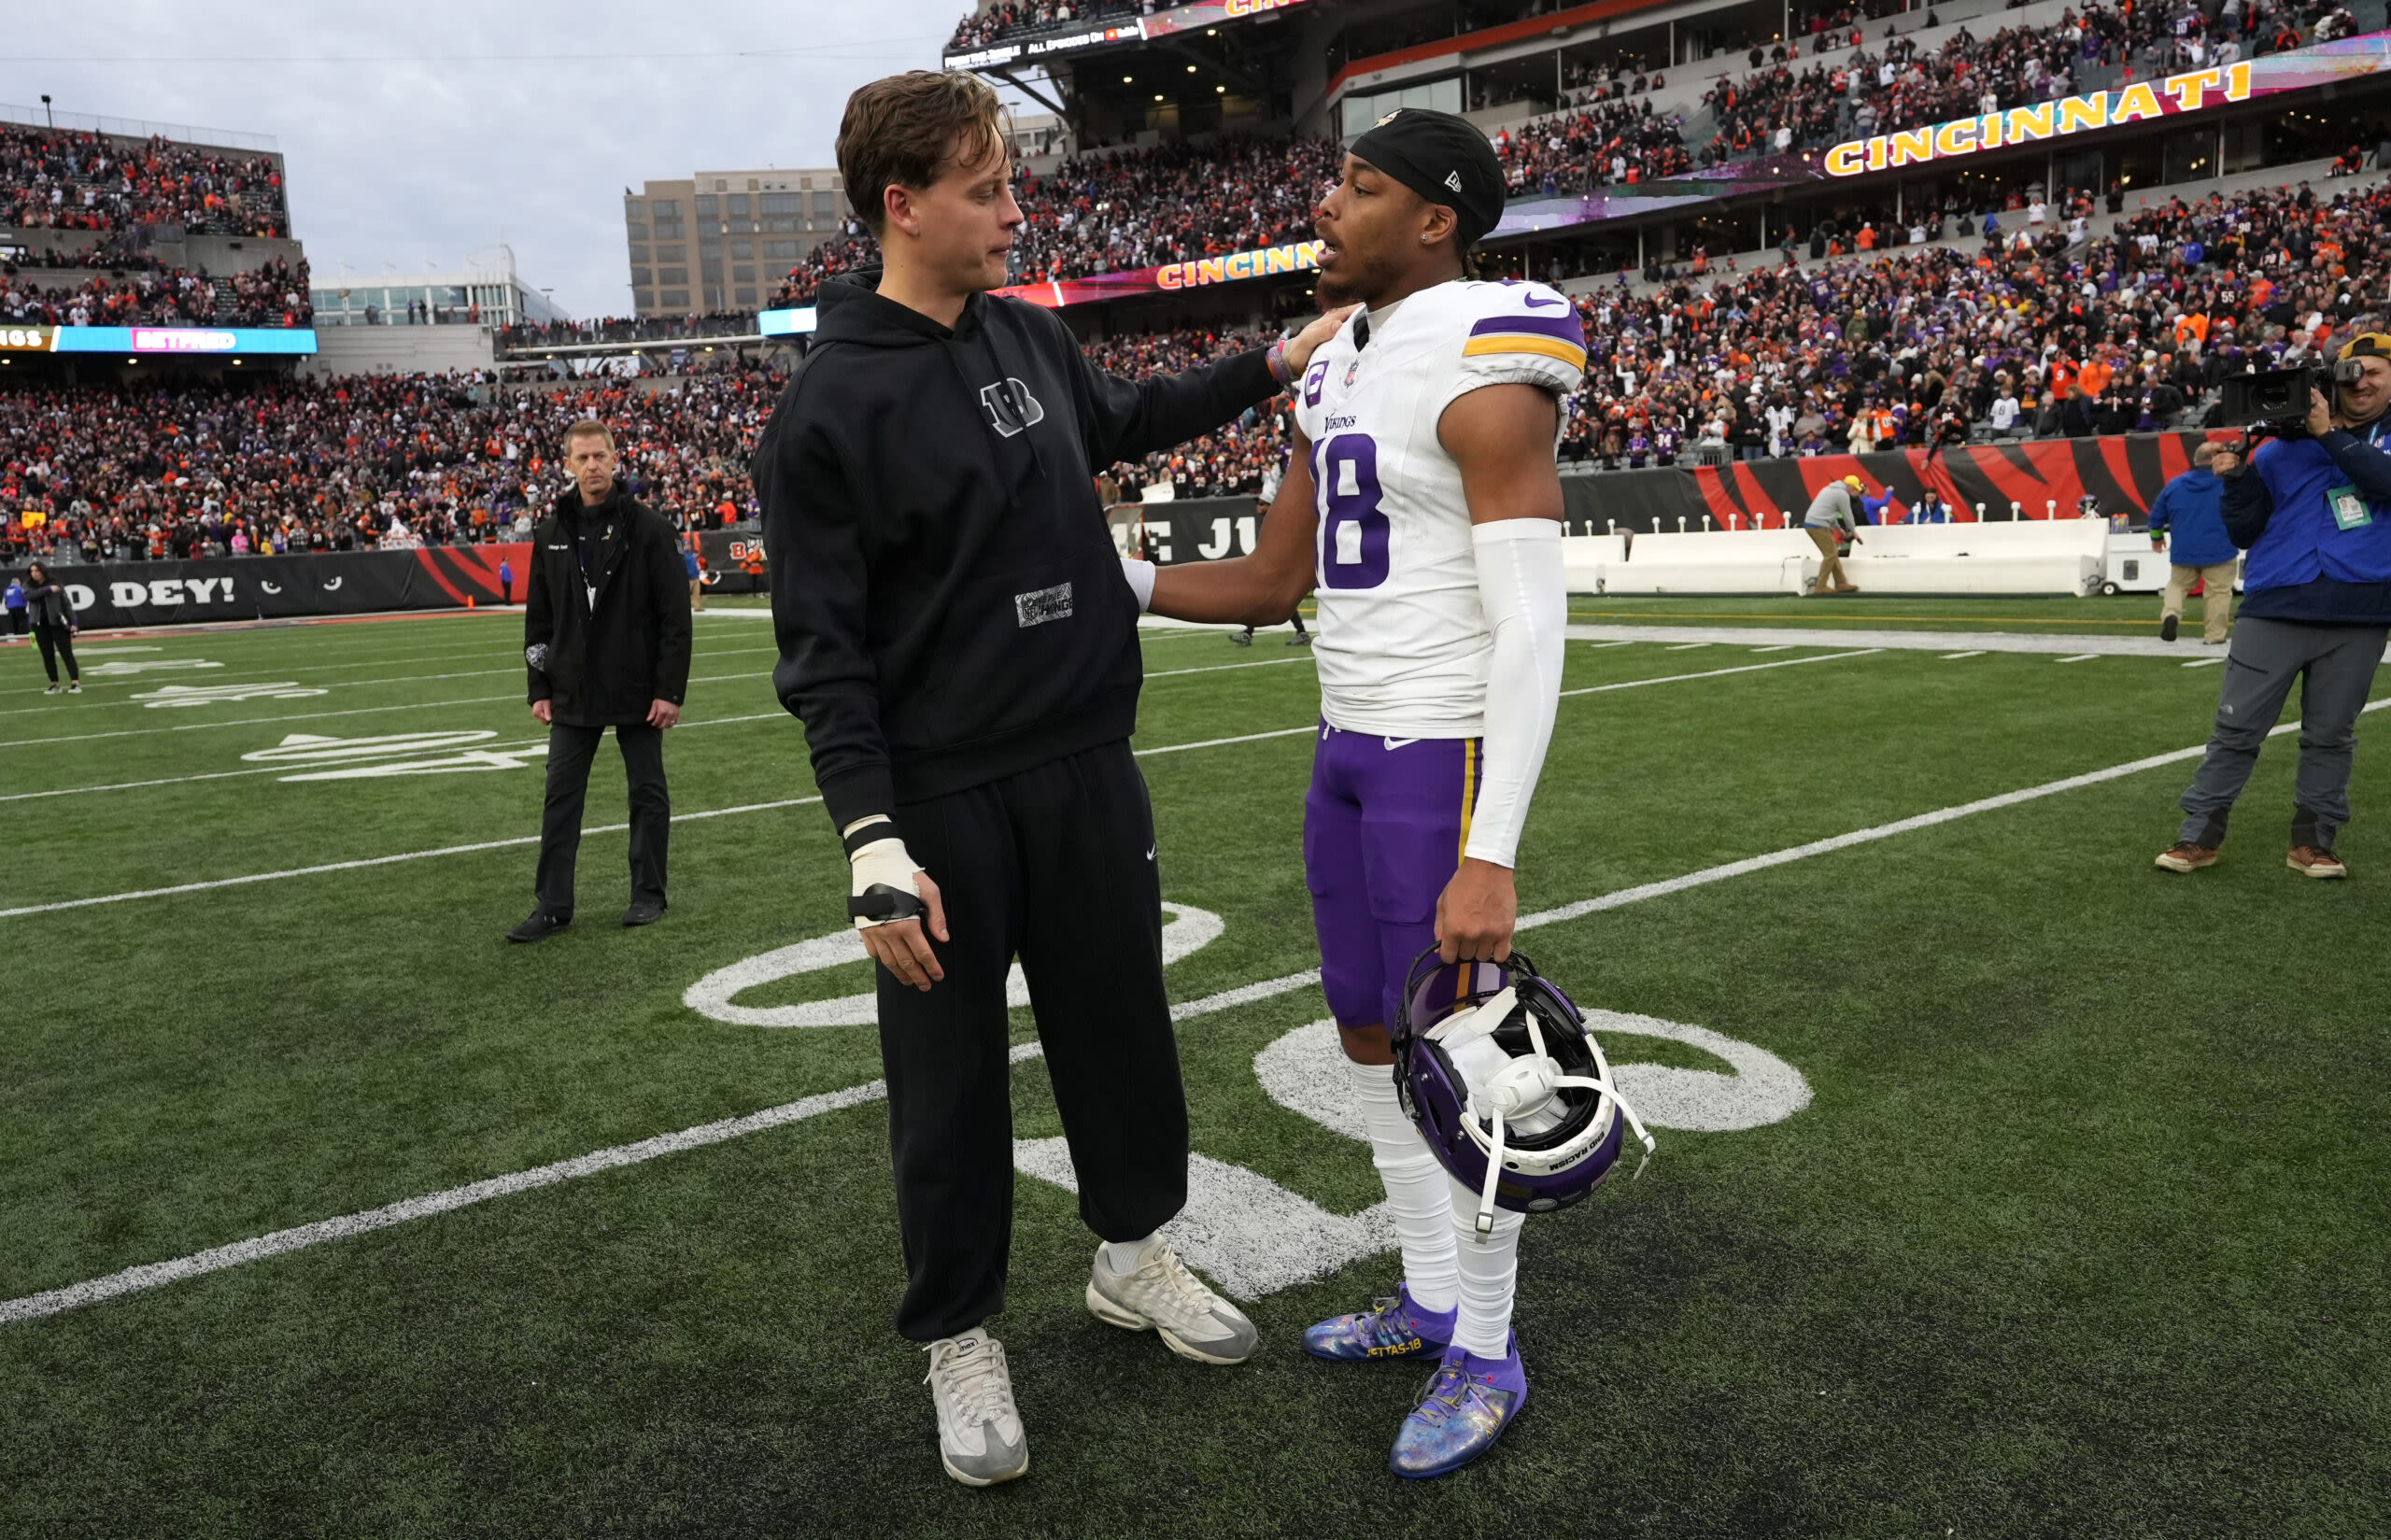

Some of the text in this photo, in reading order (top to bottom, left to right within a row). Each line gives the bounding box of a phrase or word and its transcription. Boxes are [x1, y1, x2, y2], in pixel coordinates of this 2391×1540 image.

[1824, 61, 2252, 177] CINCINNATI
[1307, 362, 1326, 396] C
[109, 577, 234, 608] DEY!
[1549, 1131, 1606, 1171] END RACISM
